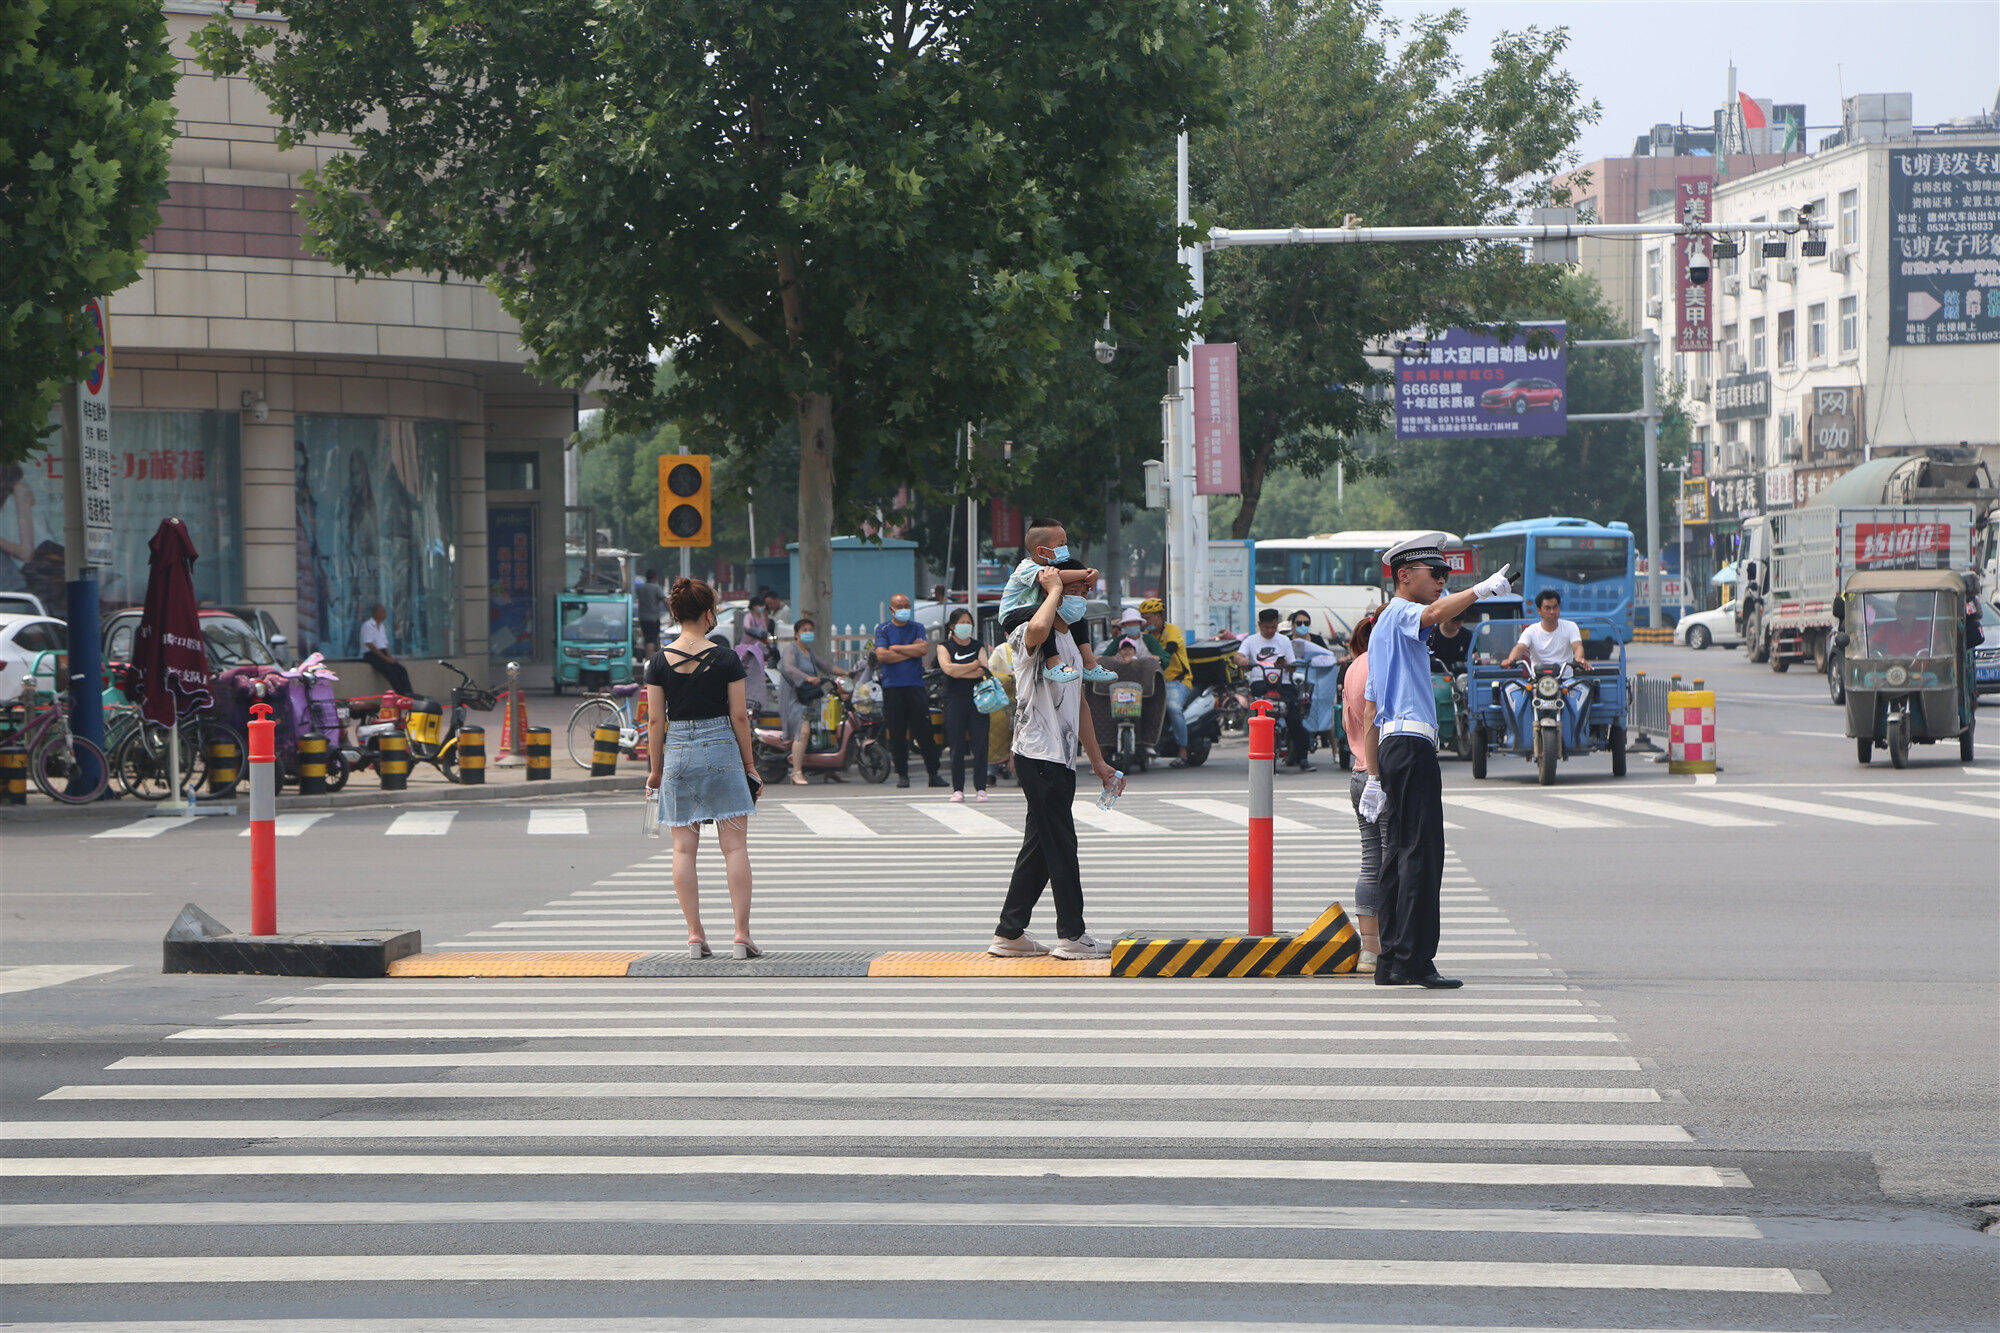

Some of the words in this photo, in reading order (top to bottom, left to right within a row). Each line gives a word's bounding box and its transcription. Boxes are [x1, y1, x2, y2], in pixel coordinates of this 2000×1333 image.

[1682, 326, 1709, 340] 分校
[1906, 330, 2000, 344] 电话：0534-261693
[1402, 382, 1463, 396] 6666包牌
